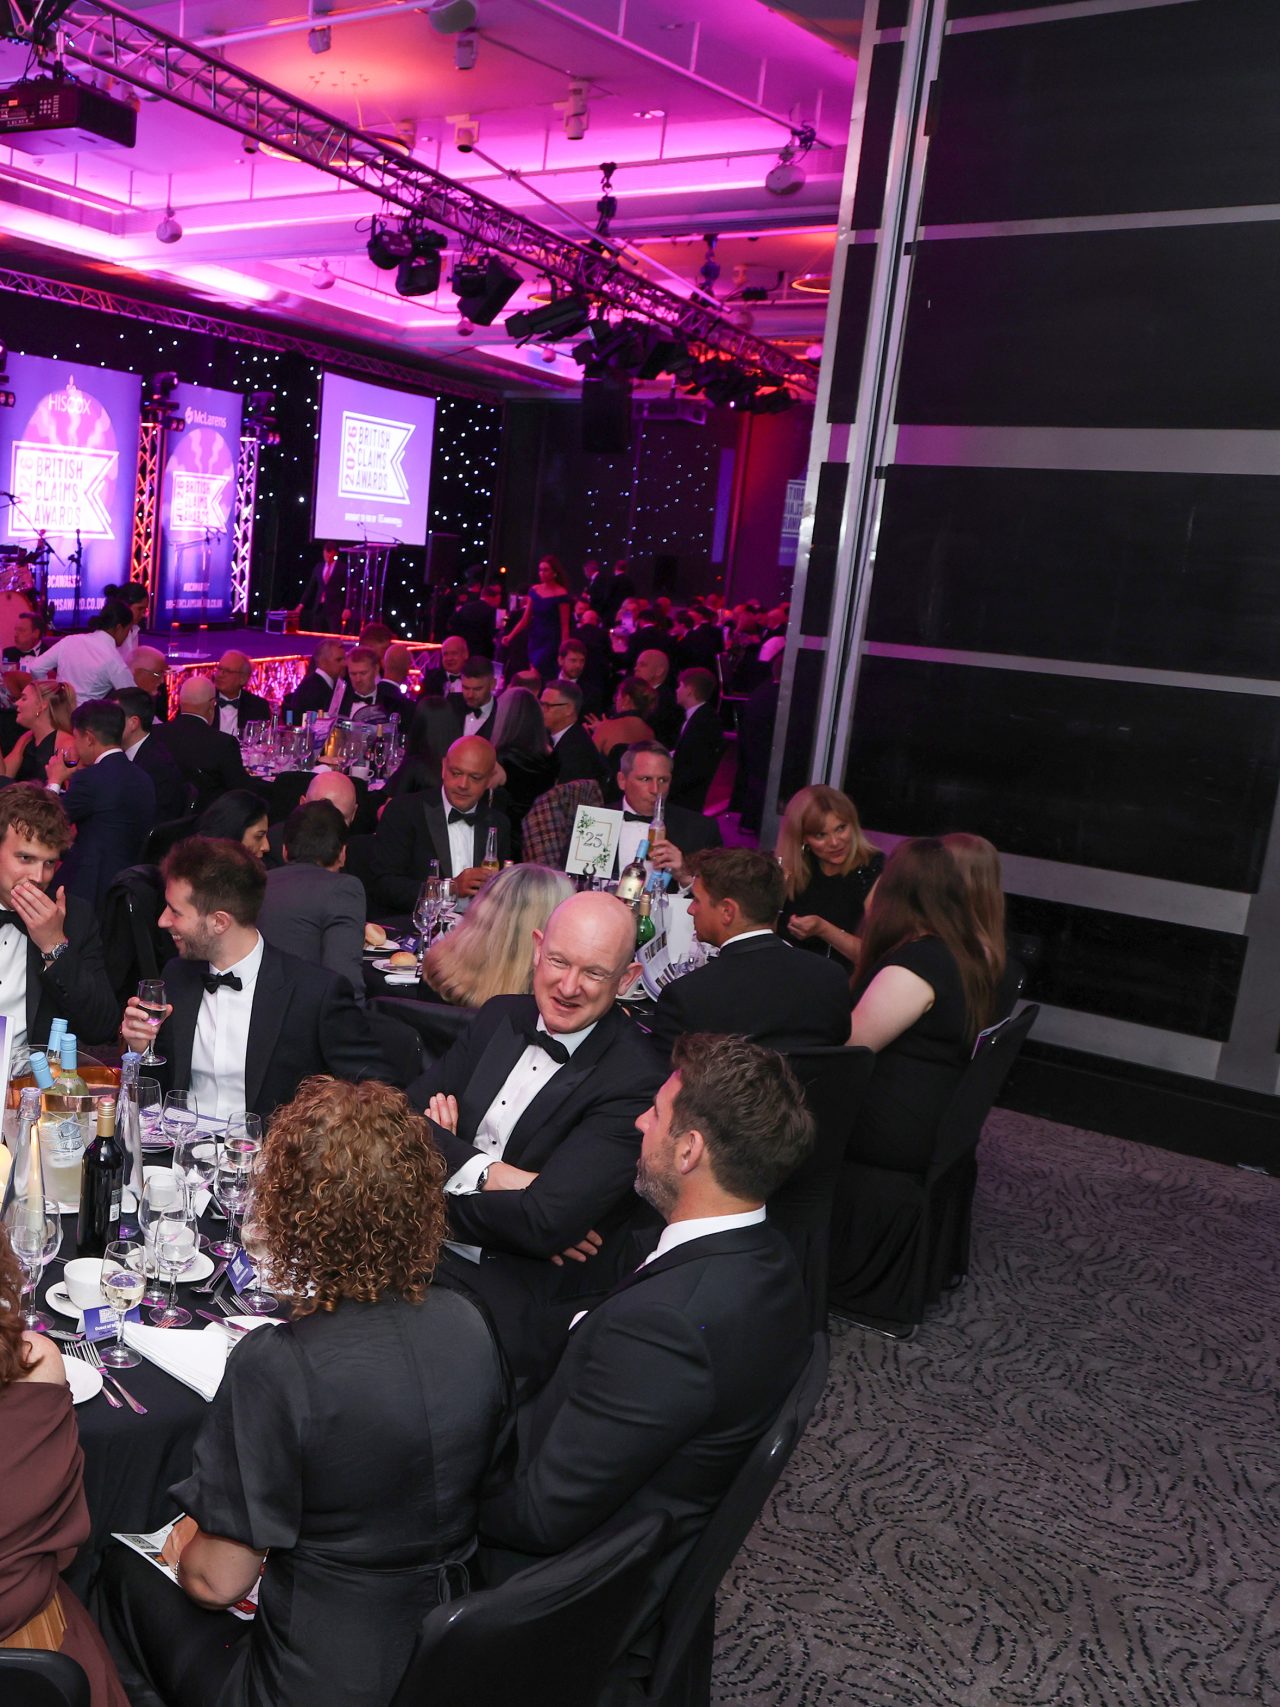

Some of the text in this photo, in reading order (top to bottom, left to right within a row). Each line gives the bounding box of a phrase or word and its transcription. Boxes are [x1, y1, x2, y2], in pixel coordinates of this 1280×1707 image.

[48, 393, 92, 415] HISCOX
[193, 409, 227, 428] McLarens
[358, 426, 391, 449] BRITISH
[344, 425, 358, 486] 2026
[357, 447, 387, 470] CLAIMS
[36, 456, 83, 479] BRITISH
[35, 480, 79, 503] CLAIMS
[34, 503, 81, 526] AWARDS
[583, 831, 604, 848] 25
